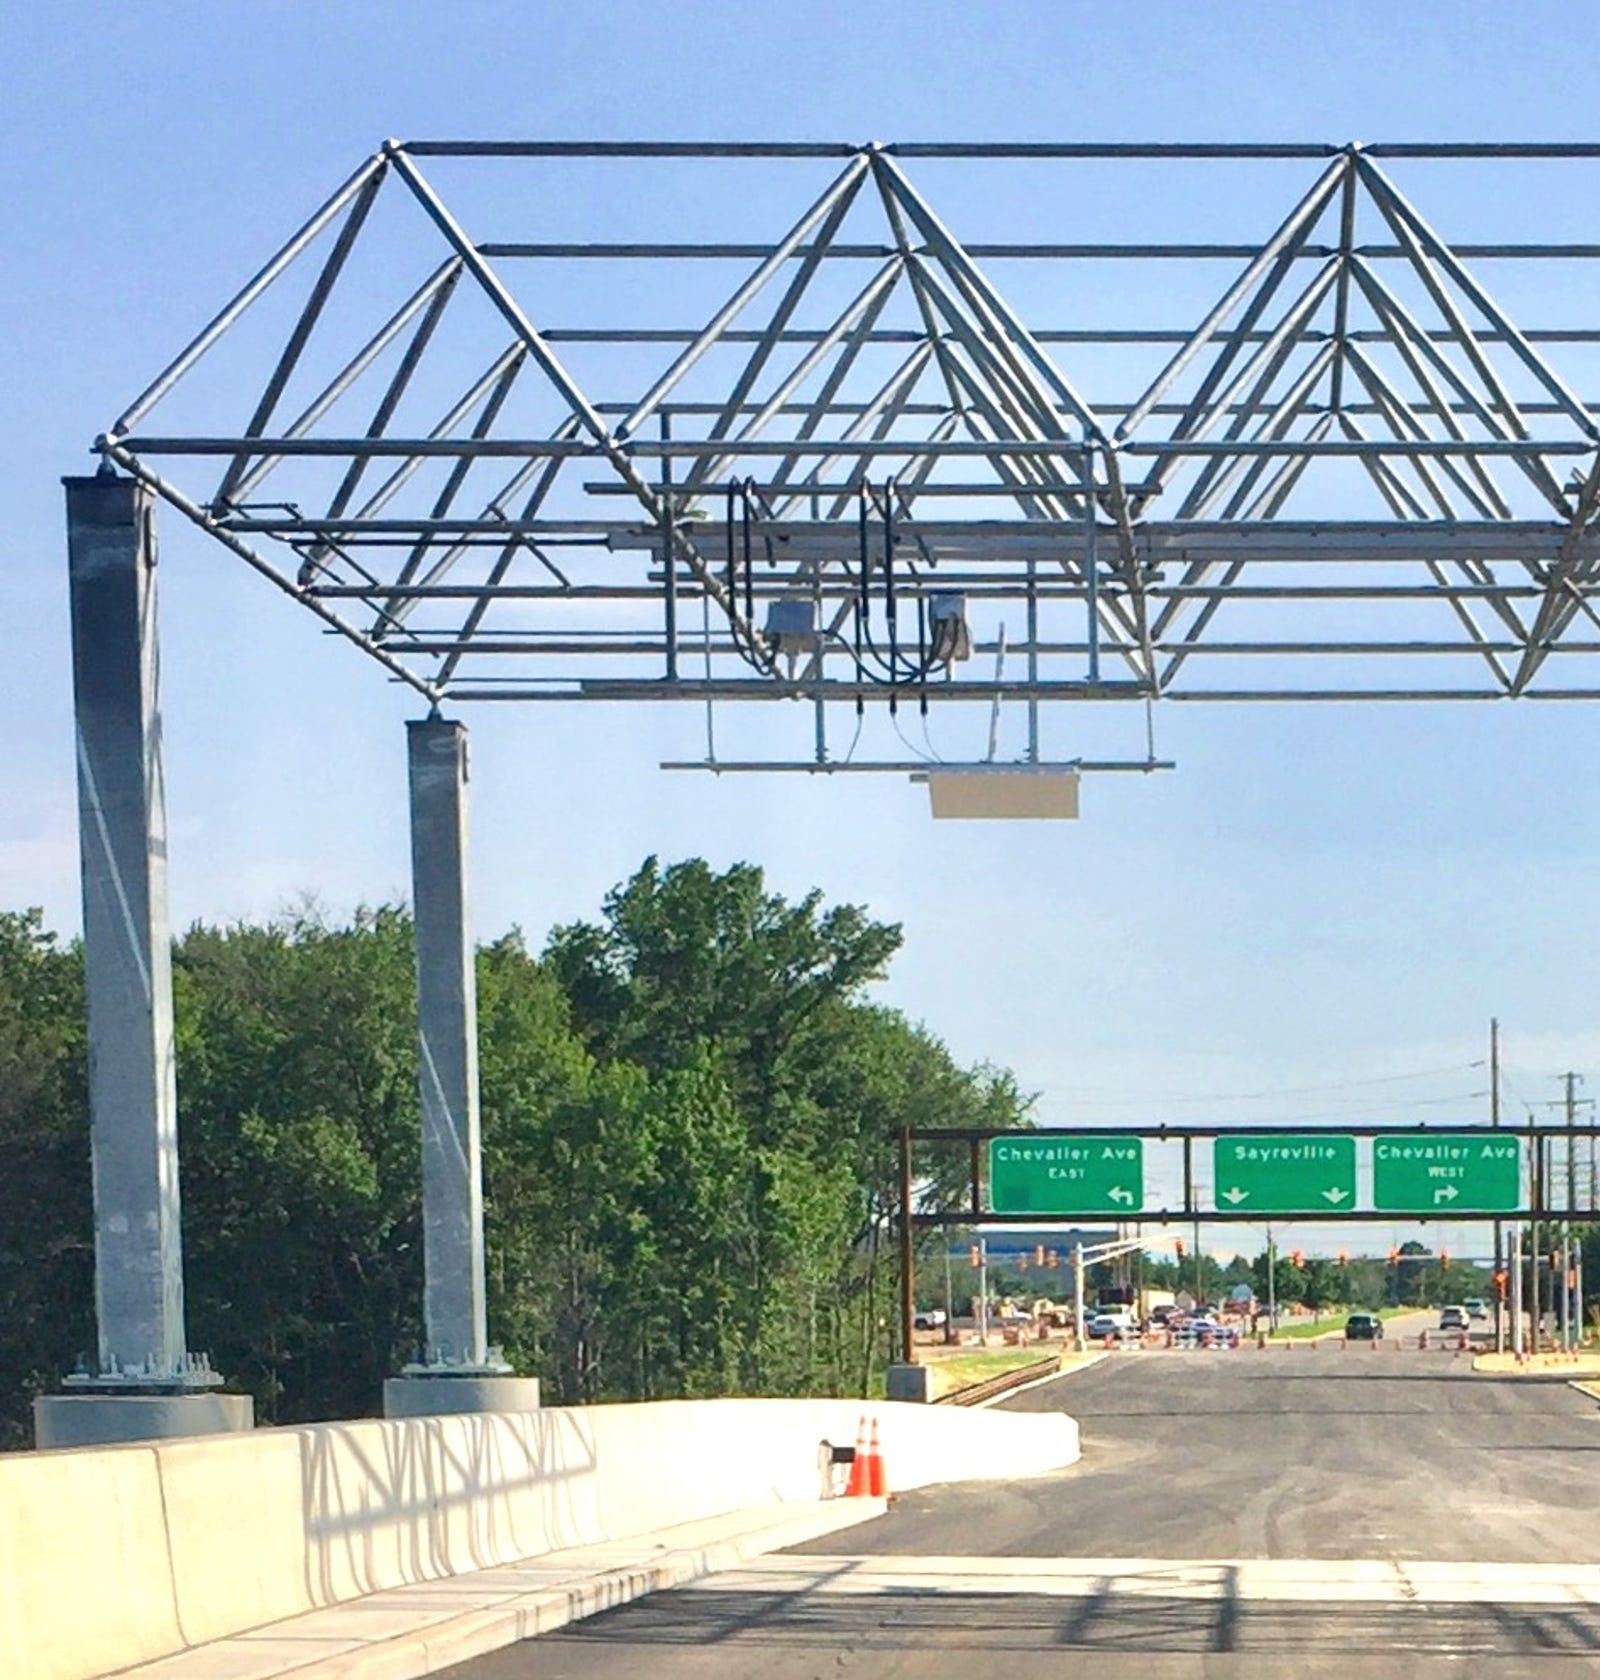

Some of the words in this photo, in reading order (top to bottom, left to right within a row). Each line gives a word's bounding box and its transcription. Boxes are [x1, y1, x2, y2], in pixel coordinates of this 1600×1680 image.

[997, 1146, 1090, 1161] Chevalier
[1101, 1146, 1137, 1160] Ave
[1234, 1144, 1336, 1162] Sayreville
[1376, 1145, 1470, 1160] Chevalier
[1481, 1145, 1517, 1159] Ave
[1048, 1168, 1085, 1179] EAST
[1428, 1166, 1465, 1178] WEST
